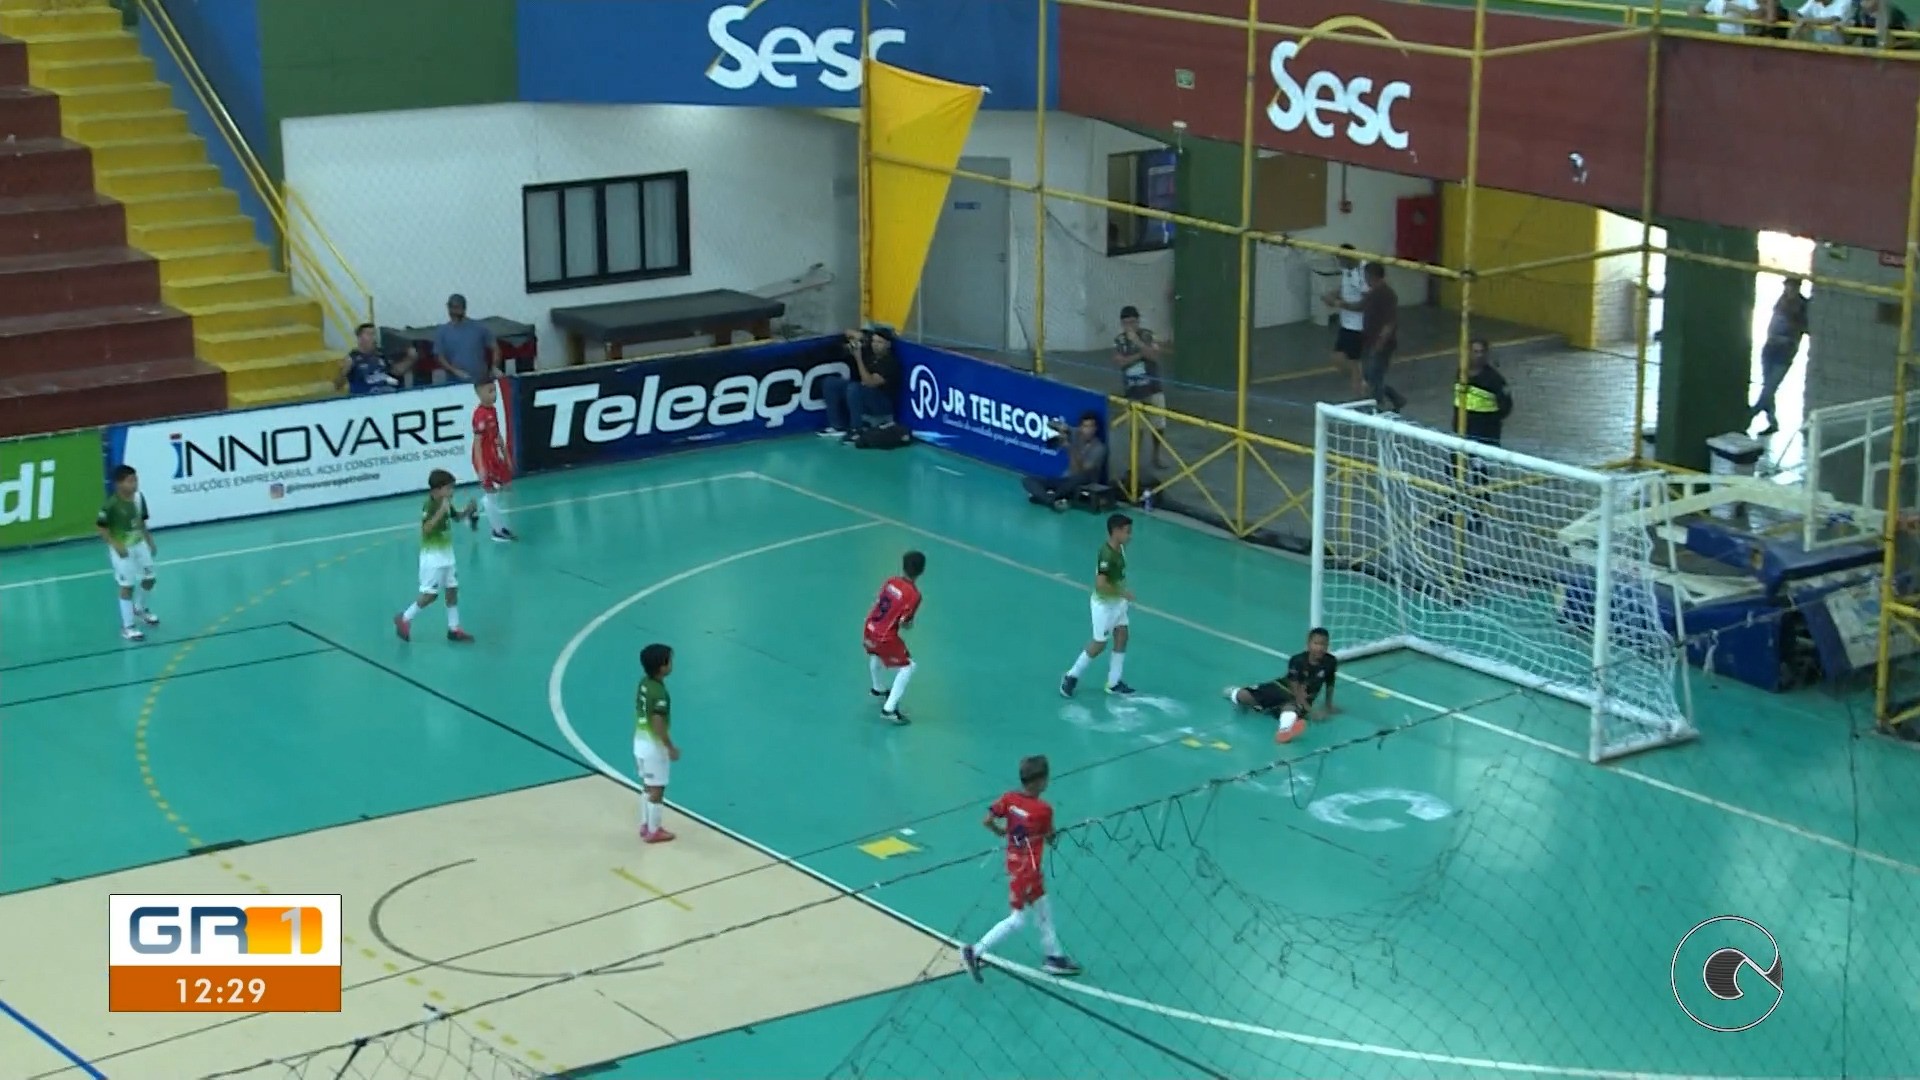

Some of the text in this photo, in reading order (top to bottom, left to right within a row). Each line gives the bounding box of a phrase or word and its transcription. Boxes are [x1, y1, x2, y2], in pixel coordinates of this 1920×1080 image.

[1266, 40, 1411, 149] Sesc
[533, 361, 850, 448] Teleaço
[942, 387, 967, 418] JR
[171, 477, 231, 495] SOLUÇÕES
[317, 463, 342, 475] AQUI
[423, 446, 465, 460] SONHOS
